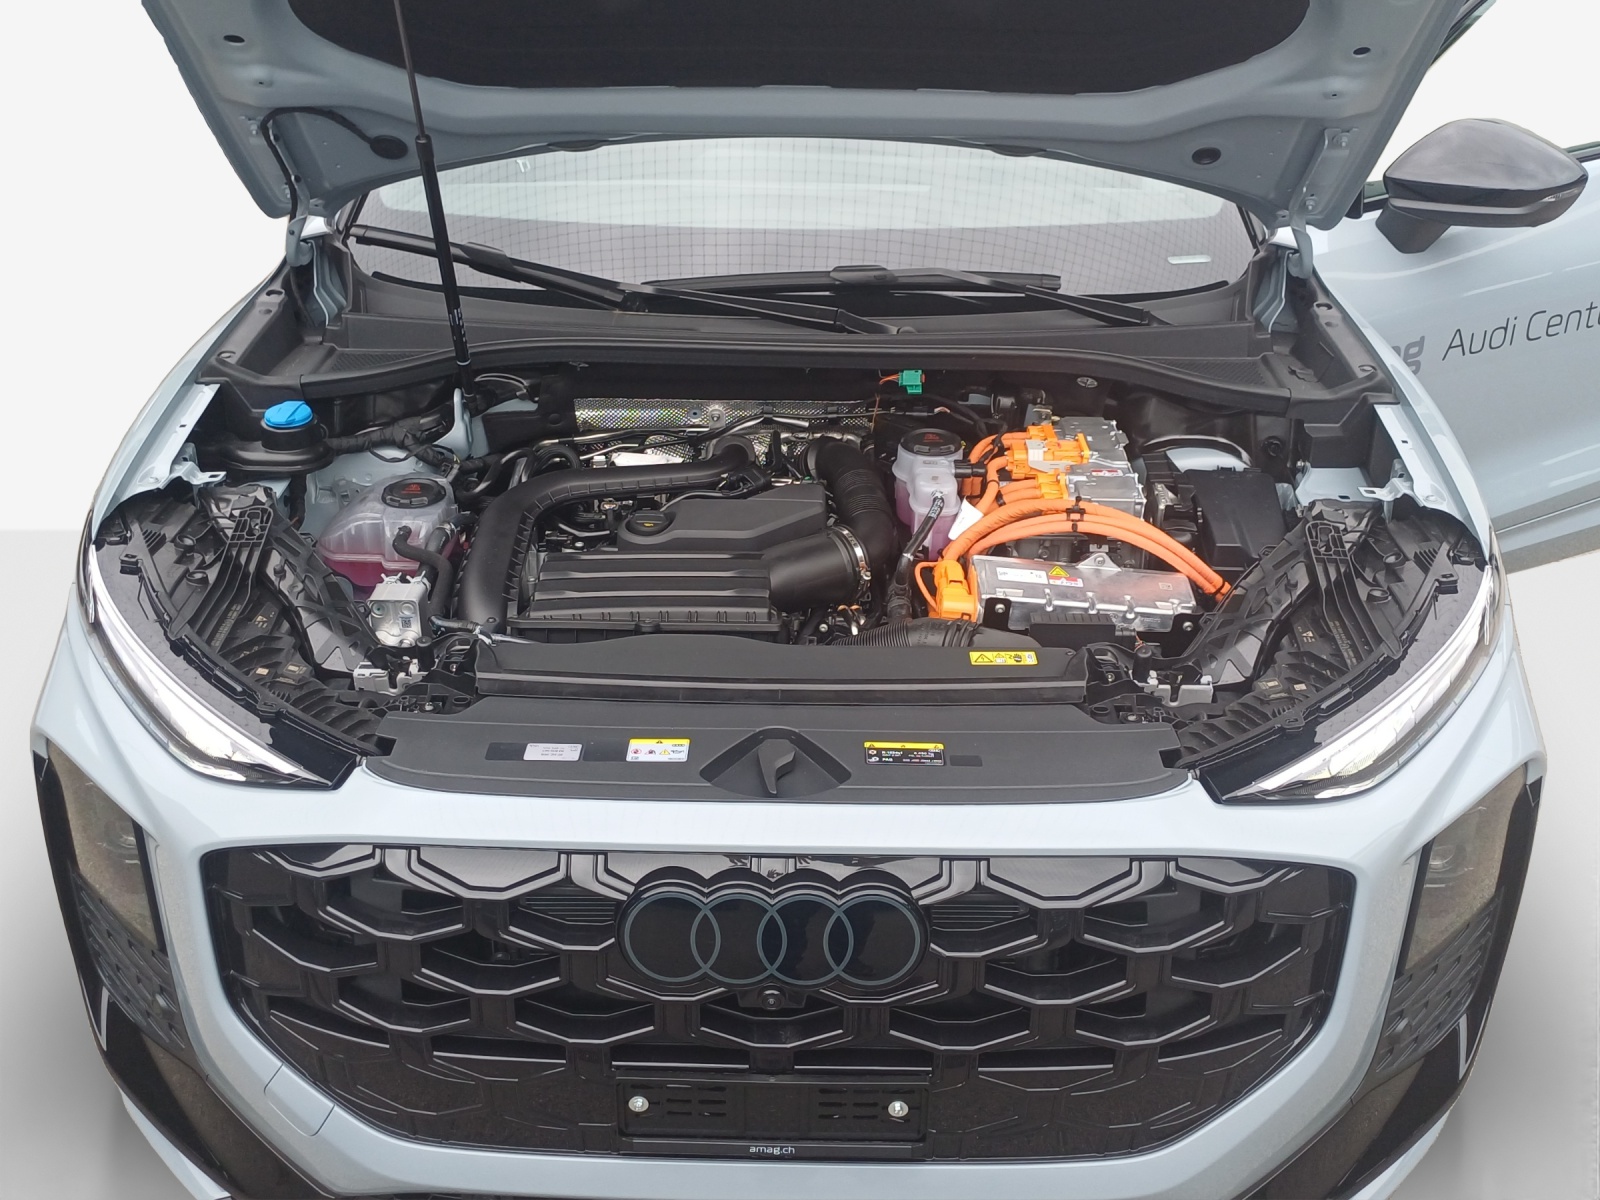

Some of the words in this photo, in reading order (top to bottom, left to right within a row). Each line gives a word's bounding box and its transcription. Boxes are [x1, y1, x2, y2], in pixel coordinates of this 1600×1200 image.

[1442, 316, 1518, 361] Audi
[1526, 301, 1600, 342] Cent
[749, 1146, 795, 1155] amag.ch
